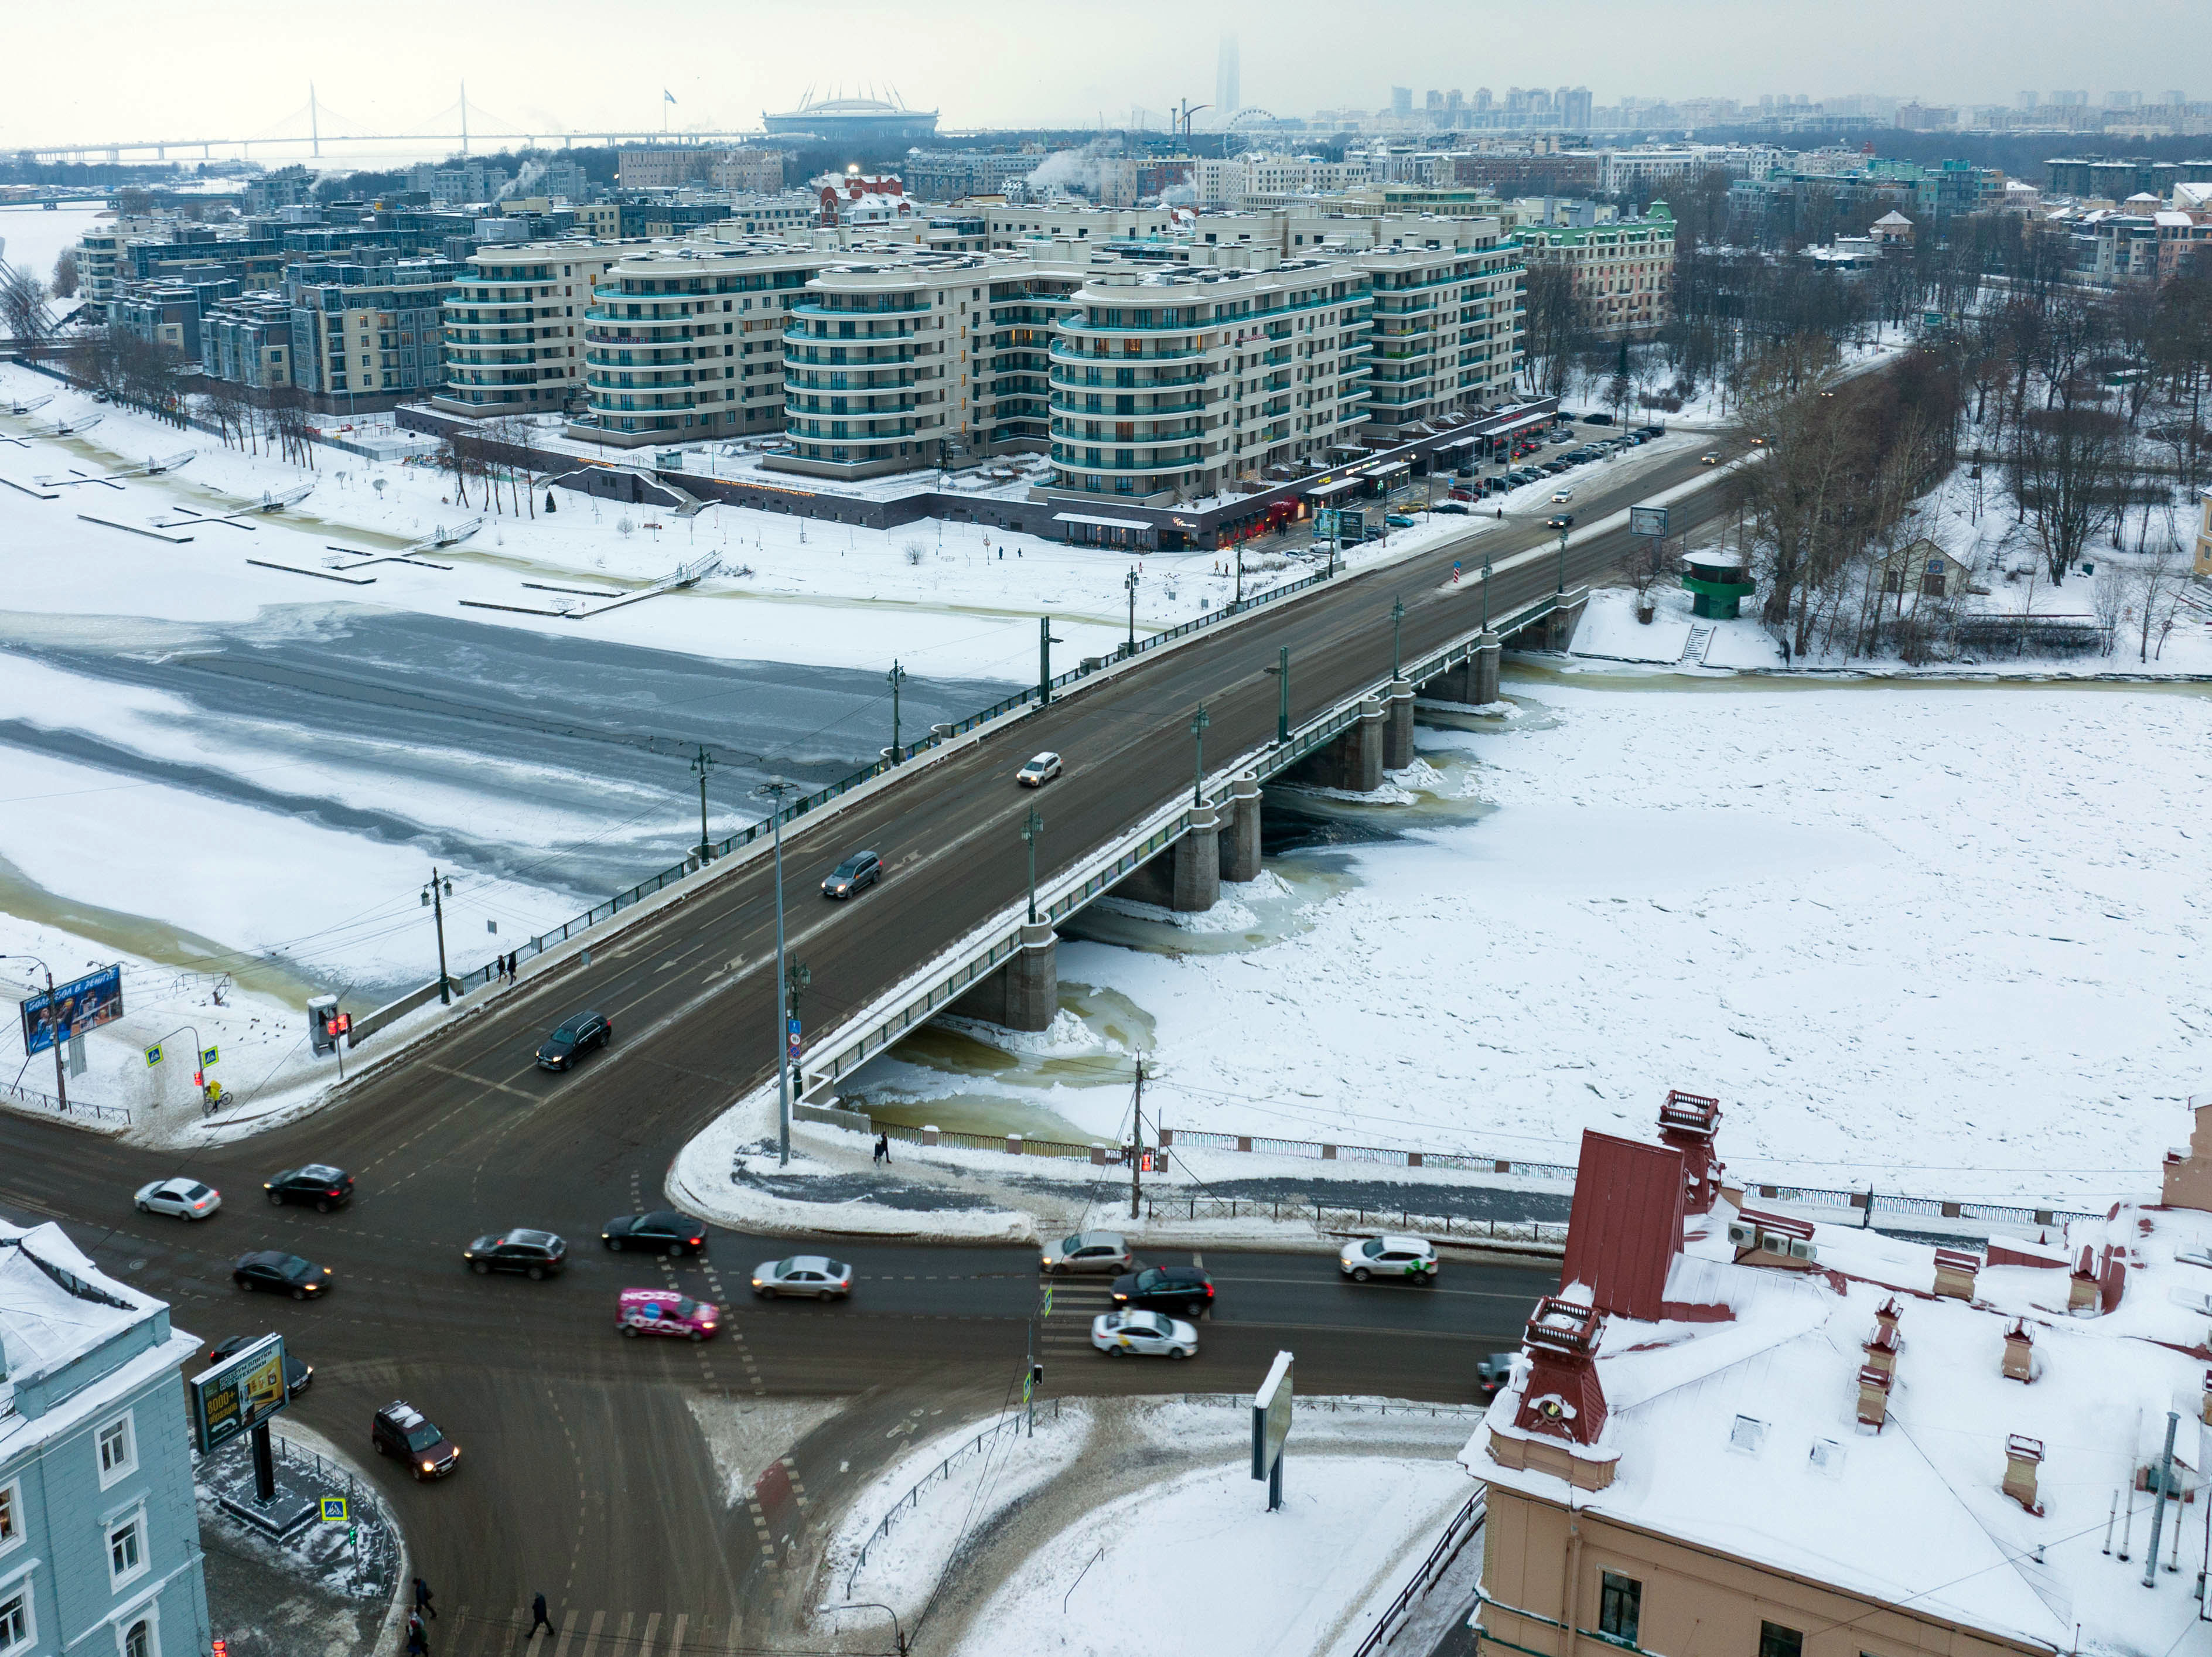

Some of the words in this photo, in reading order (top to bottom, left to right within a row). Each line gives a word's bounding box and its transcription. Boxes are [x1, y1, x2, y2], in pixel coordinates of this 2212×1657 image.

[220, 1364, 247, 1383] ШОУРУМ
[248, 1348, 272, 1367] ПЛИТКИ
[227, 1359, 267, 1387] САНТЕХНИКИ
[207, 1391, 235, 1414] 8000+
[209, 1402, 238, 1425] образцов
